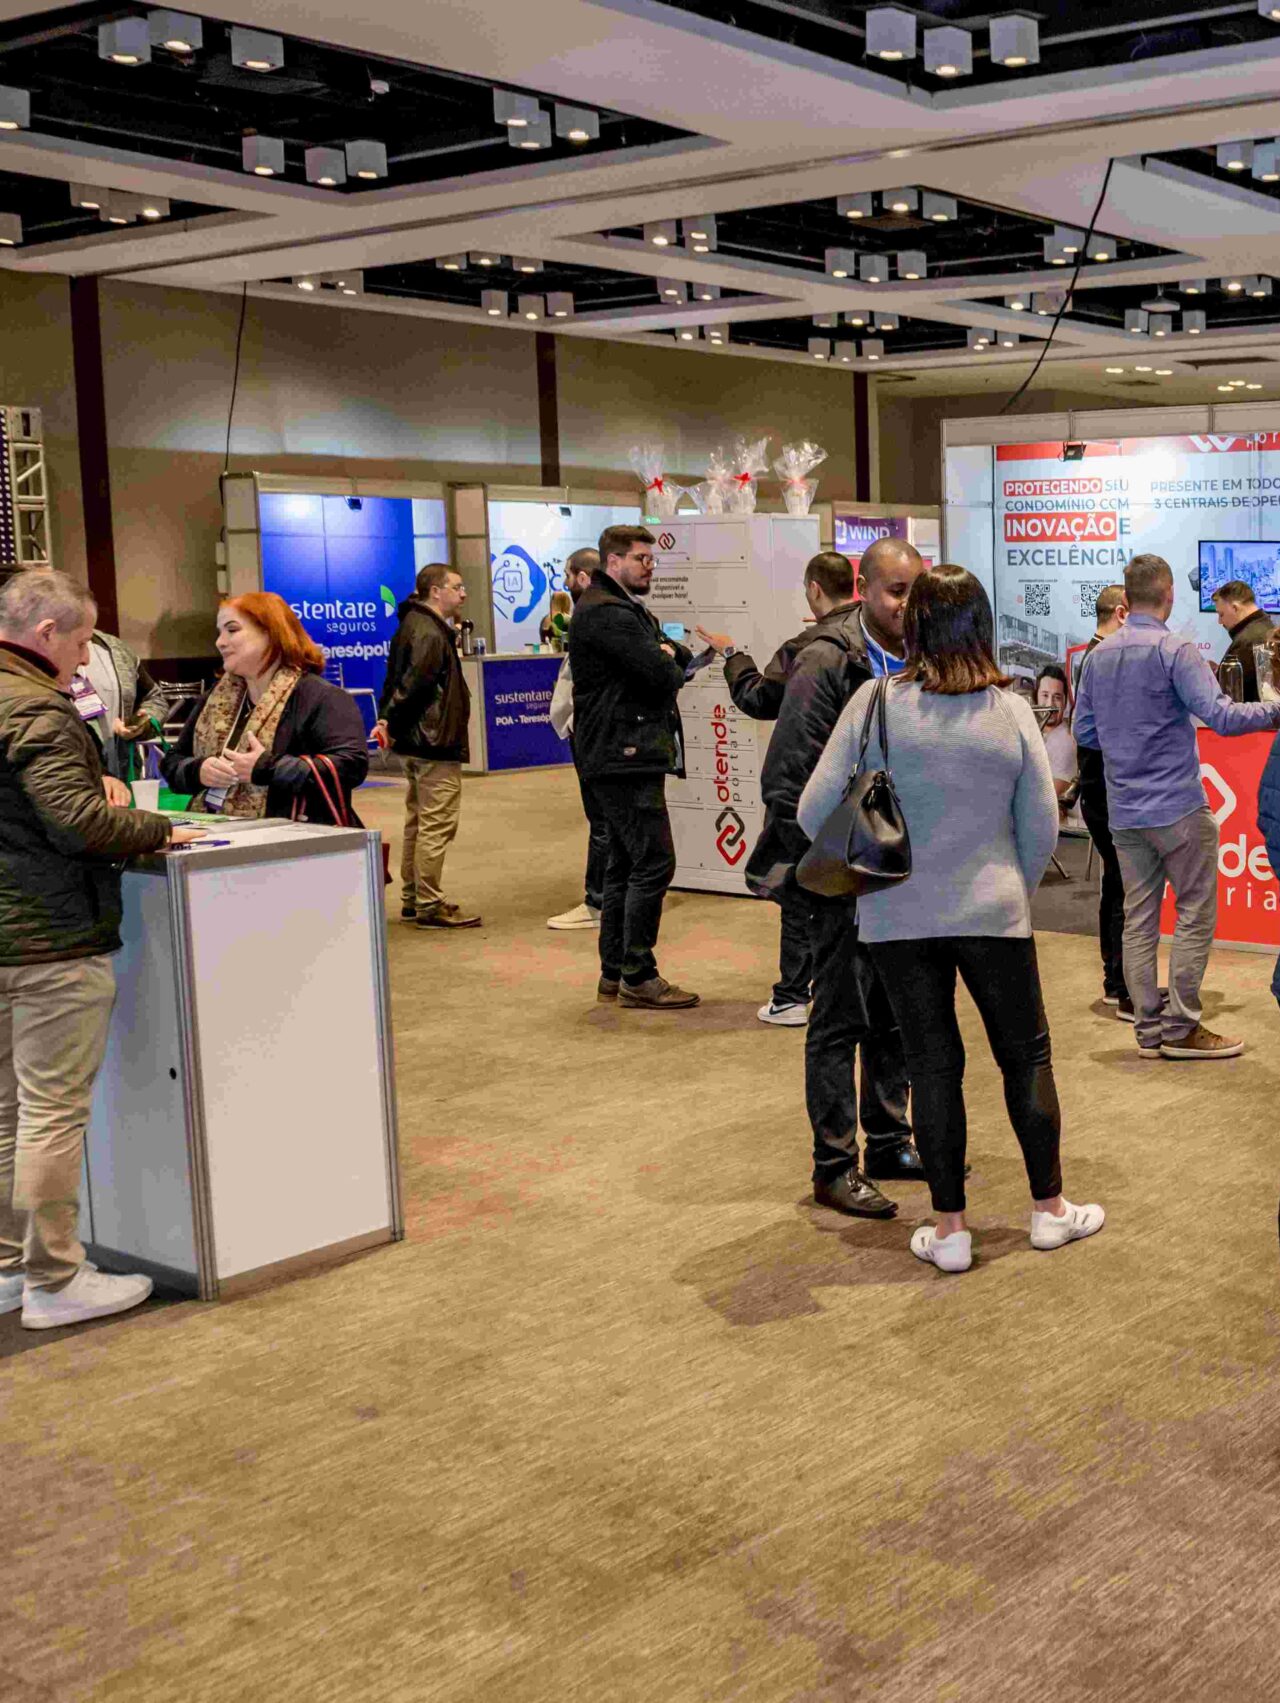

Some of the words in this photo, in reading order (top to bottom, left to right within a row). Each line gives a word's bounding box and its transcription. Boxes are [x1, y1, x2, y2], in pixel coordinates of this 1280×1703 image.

[1005, 480, 1101, 495] PROTEGENDO
[1150, 480, 1218, 492] PRESENTE
[1222, 479, 1242, 491] EM
[1005, 497, 1095, 512] CONDOMÍNIO
[1154, 498, 1161, 509] 3
[1164, 497, 1228, 509] CENTRAIS
[1231, 496, 1250, 508] DE
[848, 525, 890, 540] WIND
[1006, 513, 1115, 541] INOVAÇÃO
[1119, 517, 1132, 534] E
[290, 600, 377, 620] stentare
[326, 621, 377, 635] seguros
[495, 690, 552, 704] sustentare
[711, 704, 730, 802] atende
[727, 705, 742, 802] portaria
